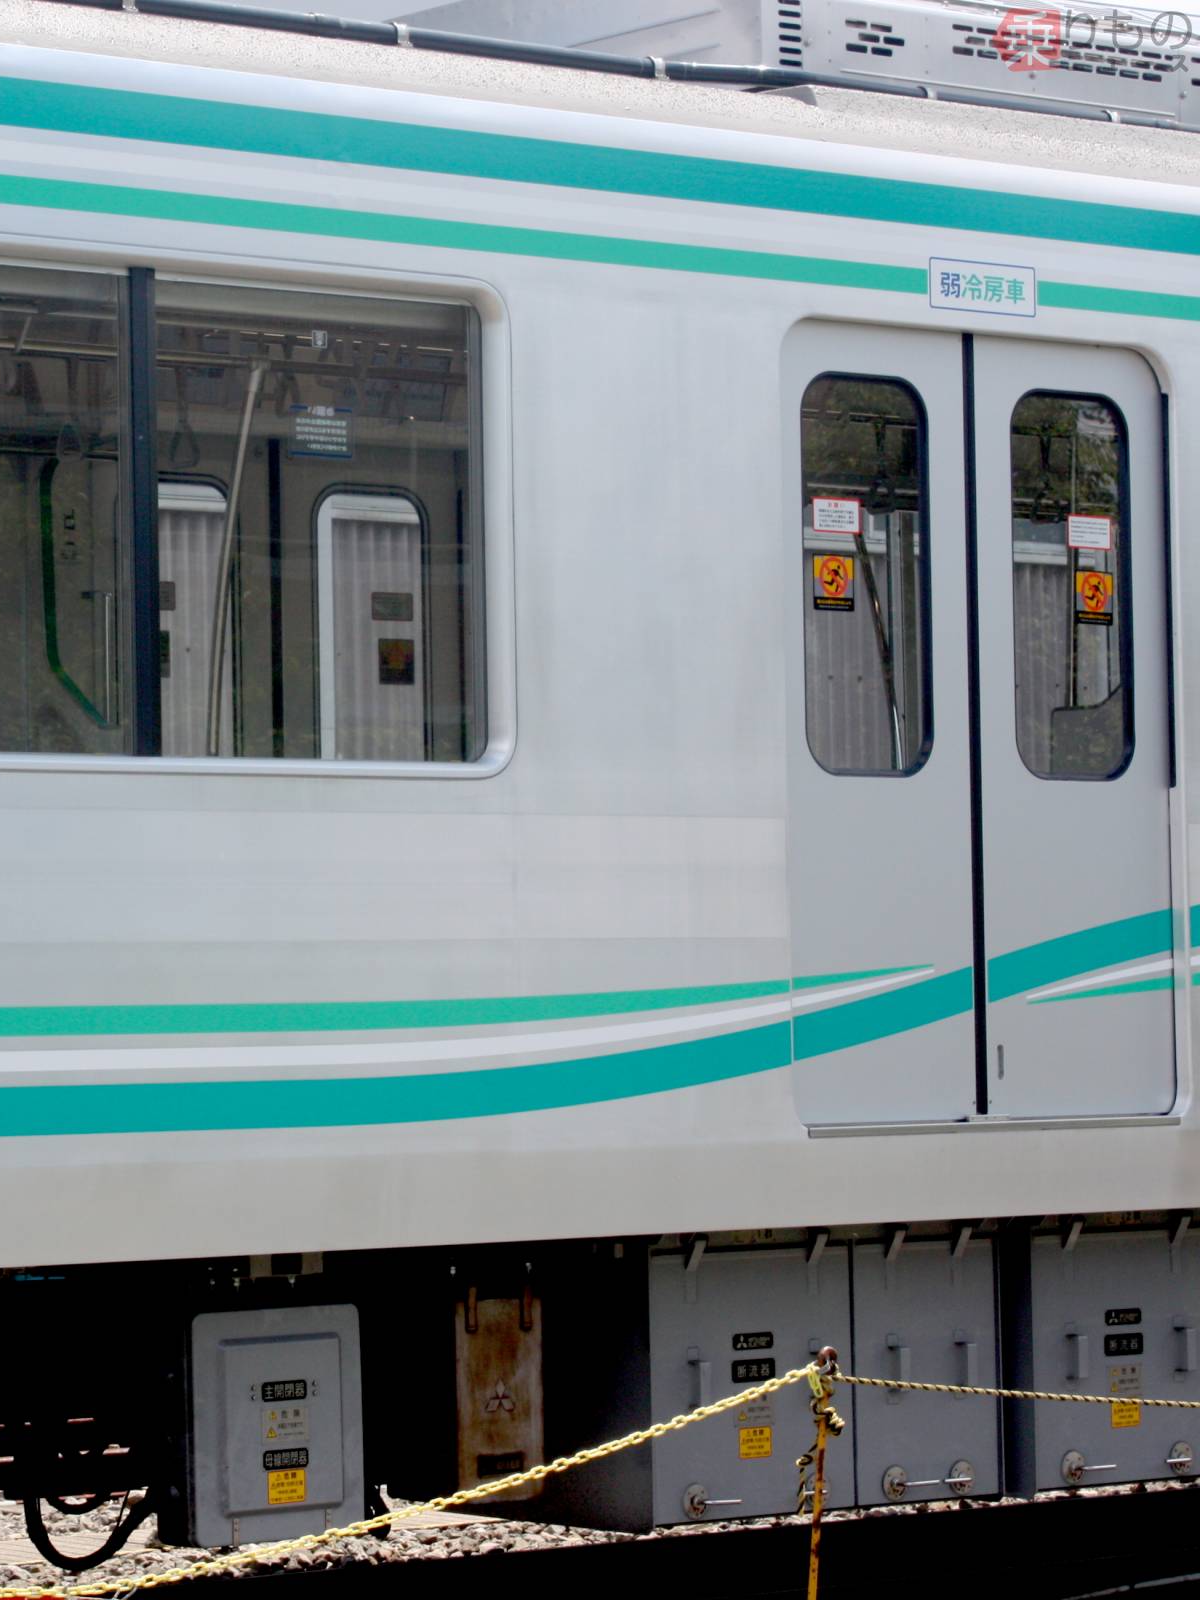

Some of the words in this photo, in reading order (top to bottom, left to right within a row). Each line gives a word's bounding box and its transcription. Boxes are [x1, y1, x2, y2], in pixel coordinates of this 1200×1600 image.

[940, 271, 1026, 305] 弱冷房車
[264, 1382, 305, 1400] 主開閉器
